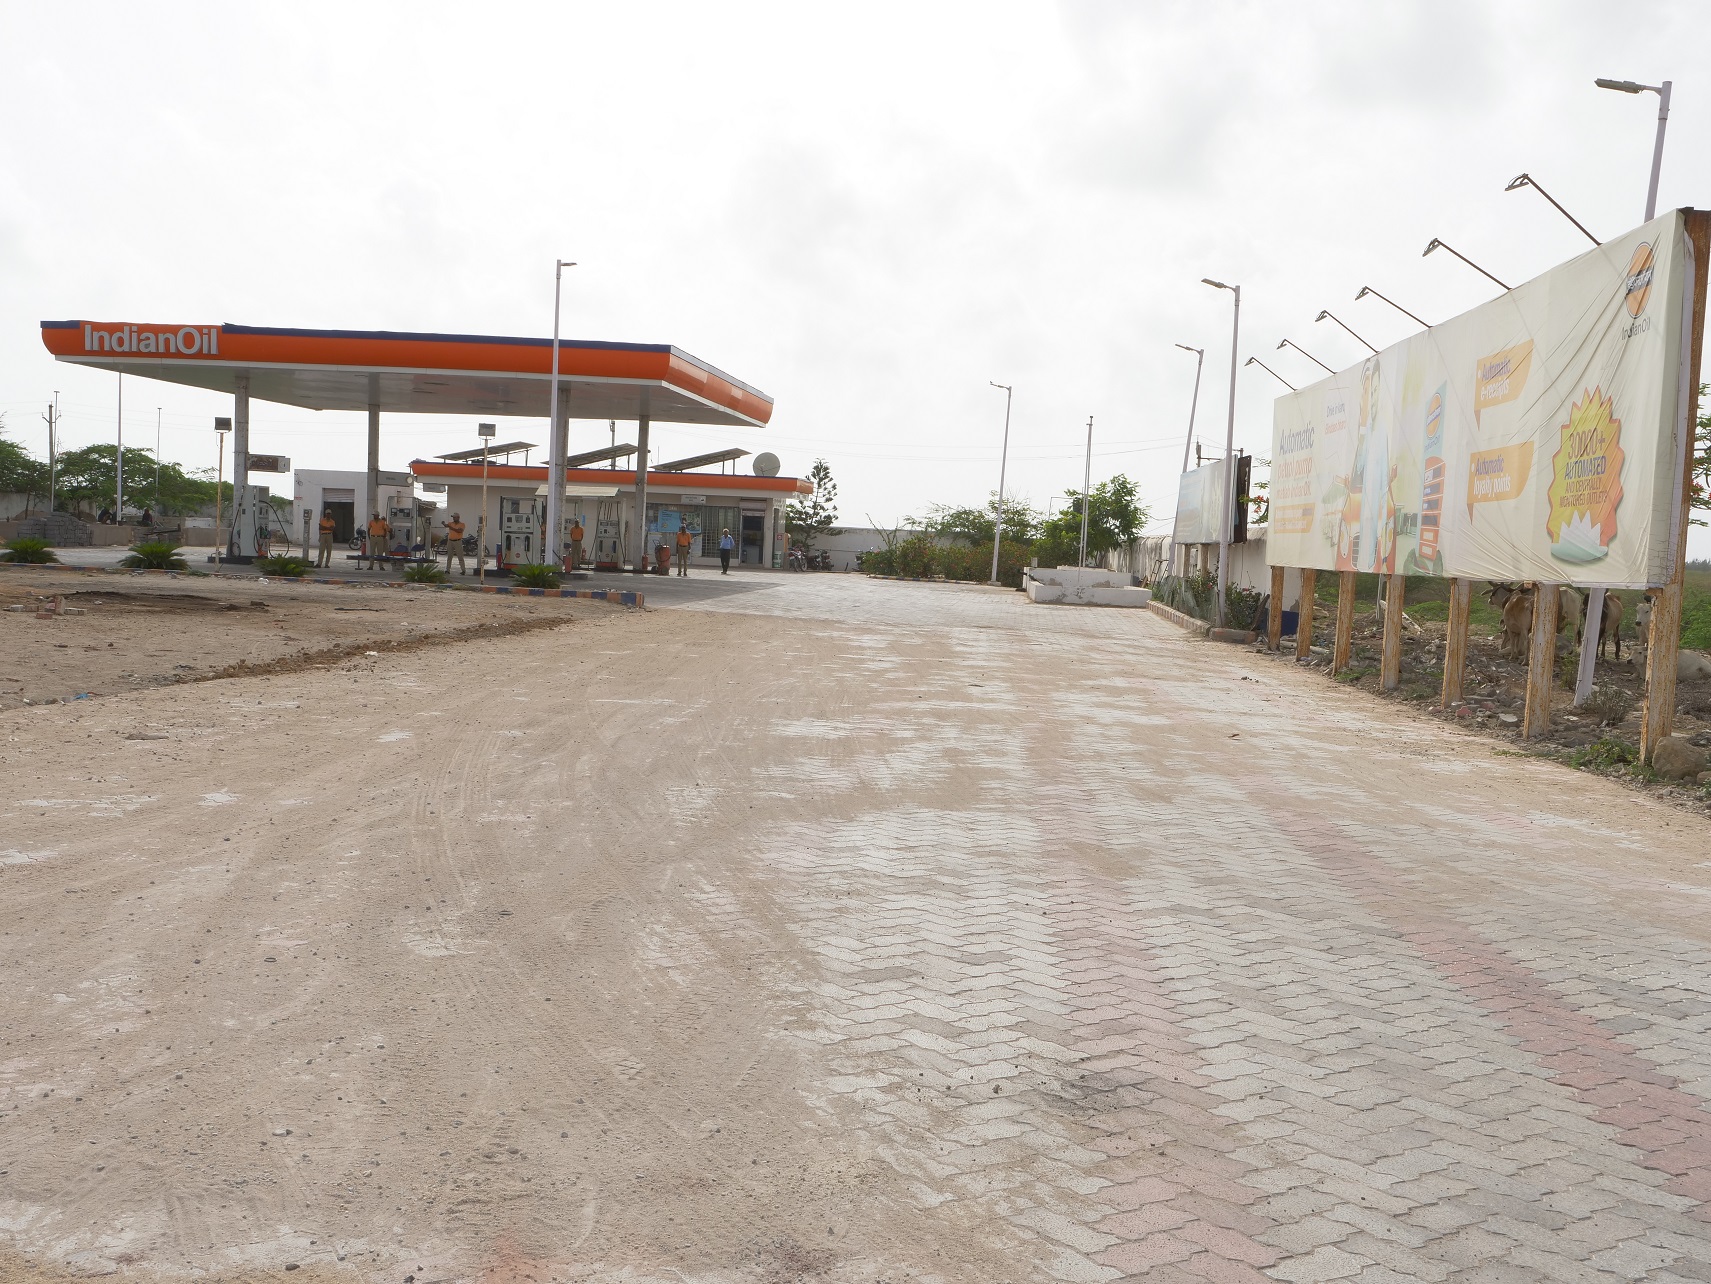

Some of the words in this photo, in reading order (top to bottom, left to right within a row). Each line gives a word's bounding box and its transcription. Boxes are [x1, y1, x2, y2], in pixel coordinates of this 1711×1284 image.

[84, 324, 218, 355] IndianOil
[1621, 317, 1651, 341] IndianOil
[1482, 357, 1511, 382] Automatic
[1279, 421, 1314, 456] Automatic
[1567, 429, 1606, 460] 30000+
[1475, 454, 1504, 476] Automatic
[1563, 455, 1607, 481] AUTOMATED
[1473, 475, 1492, 499] loyalty
[1492, 472, 1511, 498] points
